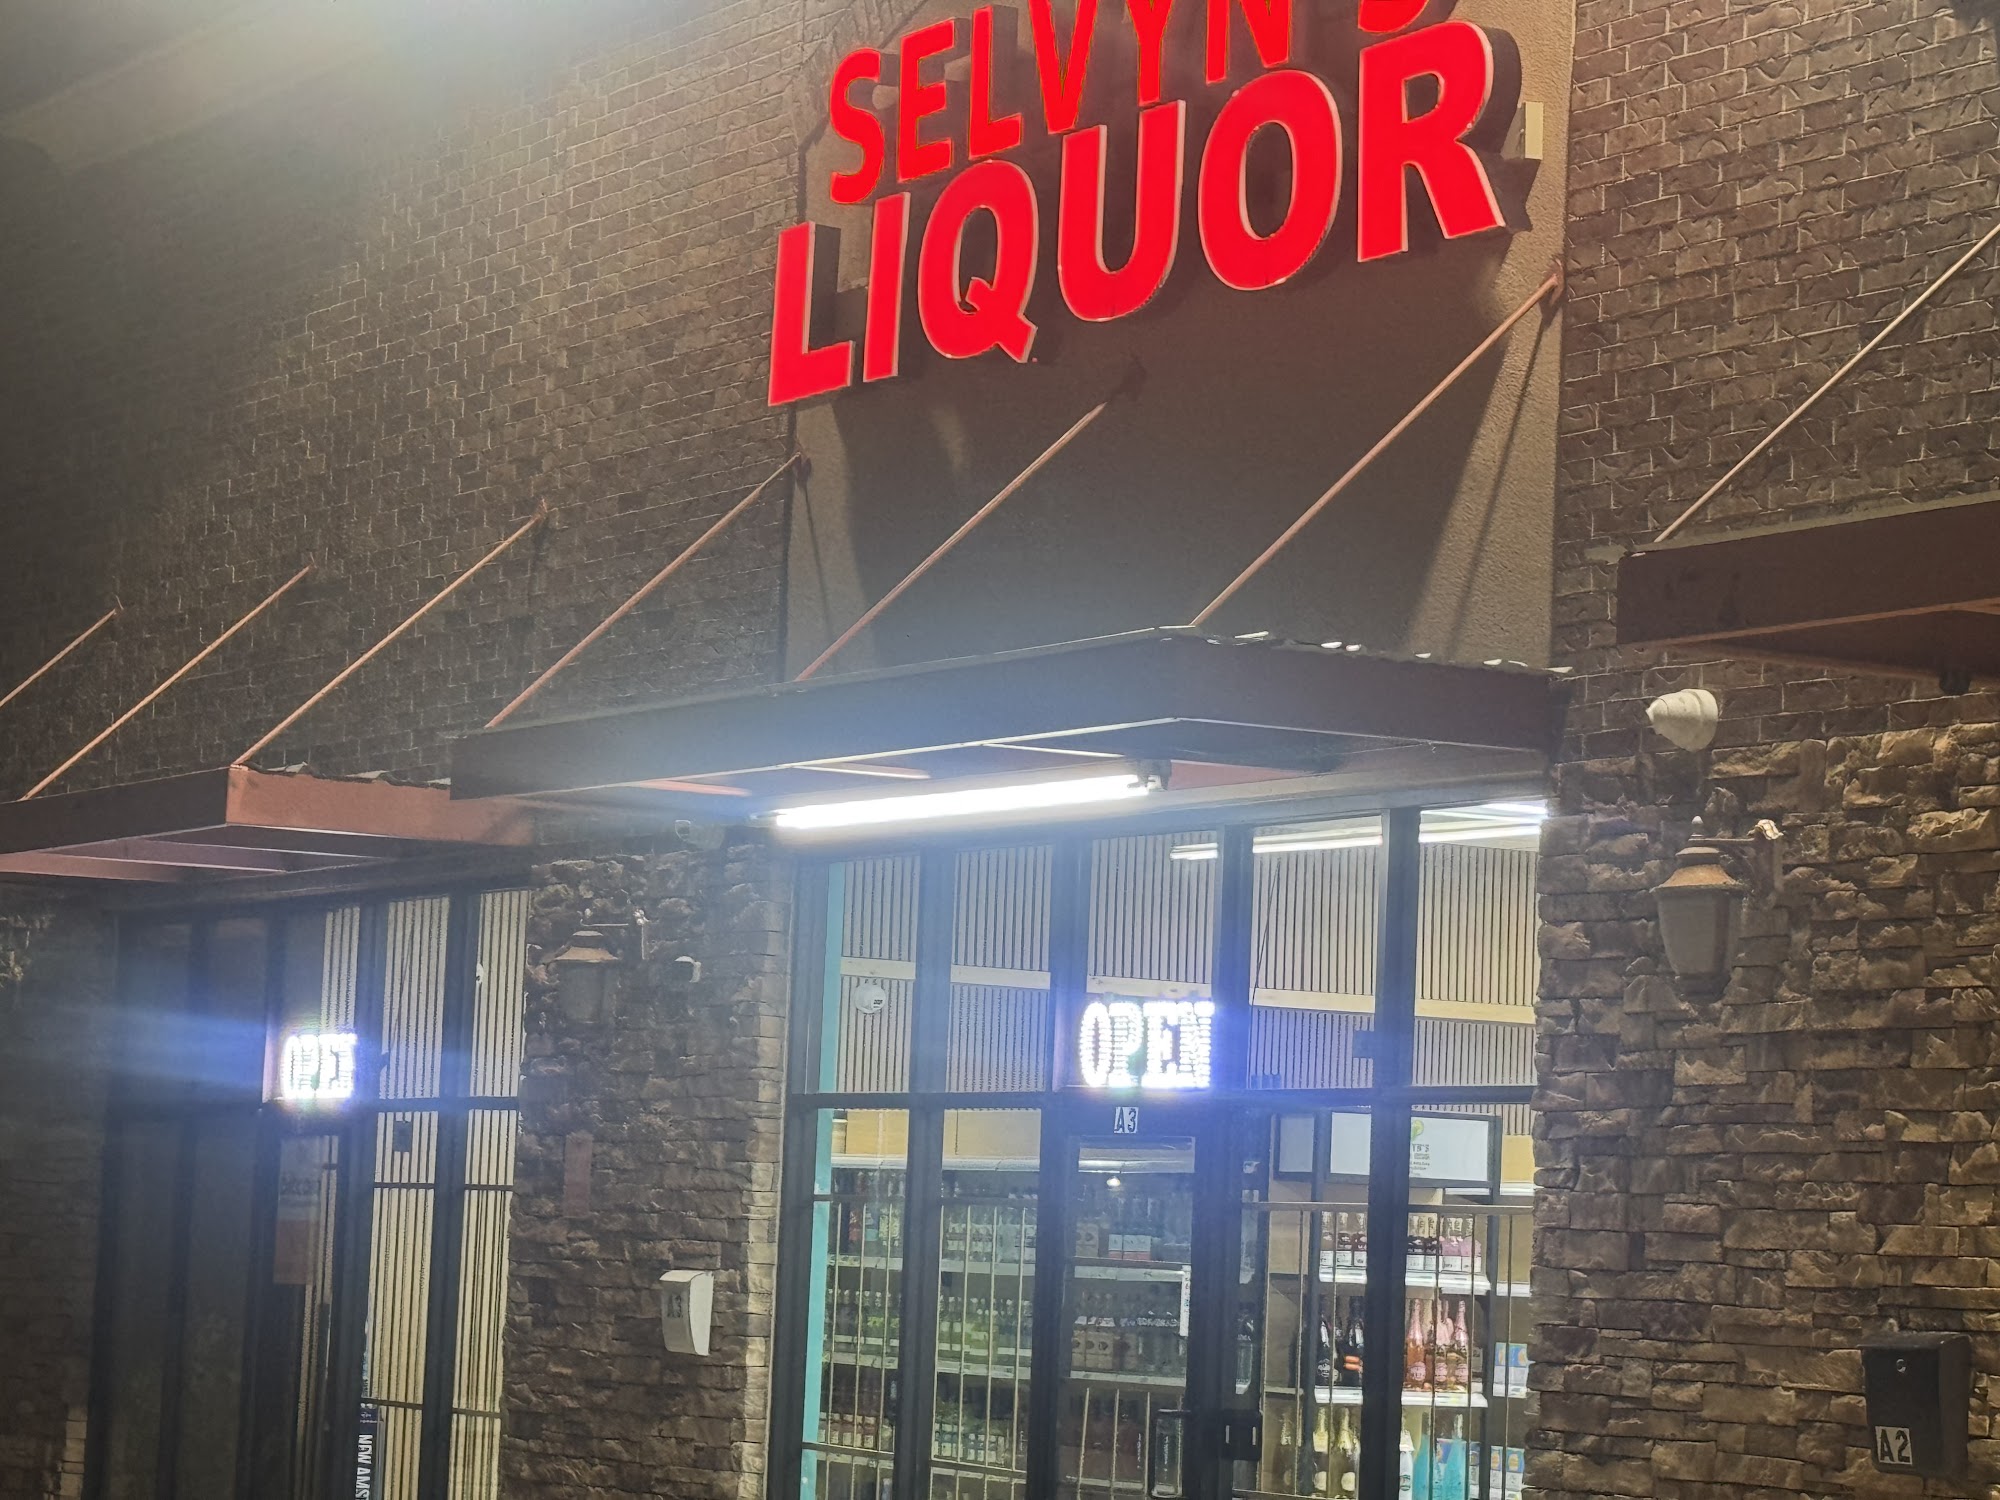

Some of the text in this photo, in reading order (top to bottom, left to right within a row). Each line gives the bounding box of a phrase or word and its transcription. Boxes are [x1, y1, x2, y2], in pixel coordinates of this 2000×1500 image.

[828, 0, 1428, 205] SELVYN
[768, 19, 1506, 407] LIQUOR
[1080, 1001, 1215, 1088] OPEN
[1114, 1107, 1137, 1133] A3
[1879, 1428, 1911, 1463] A2
[355, 1466, 371, 1500] AMS
